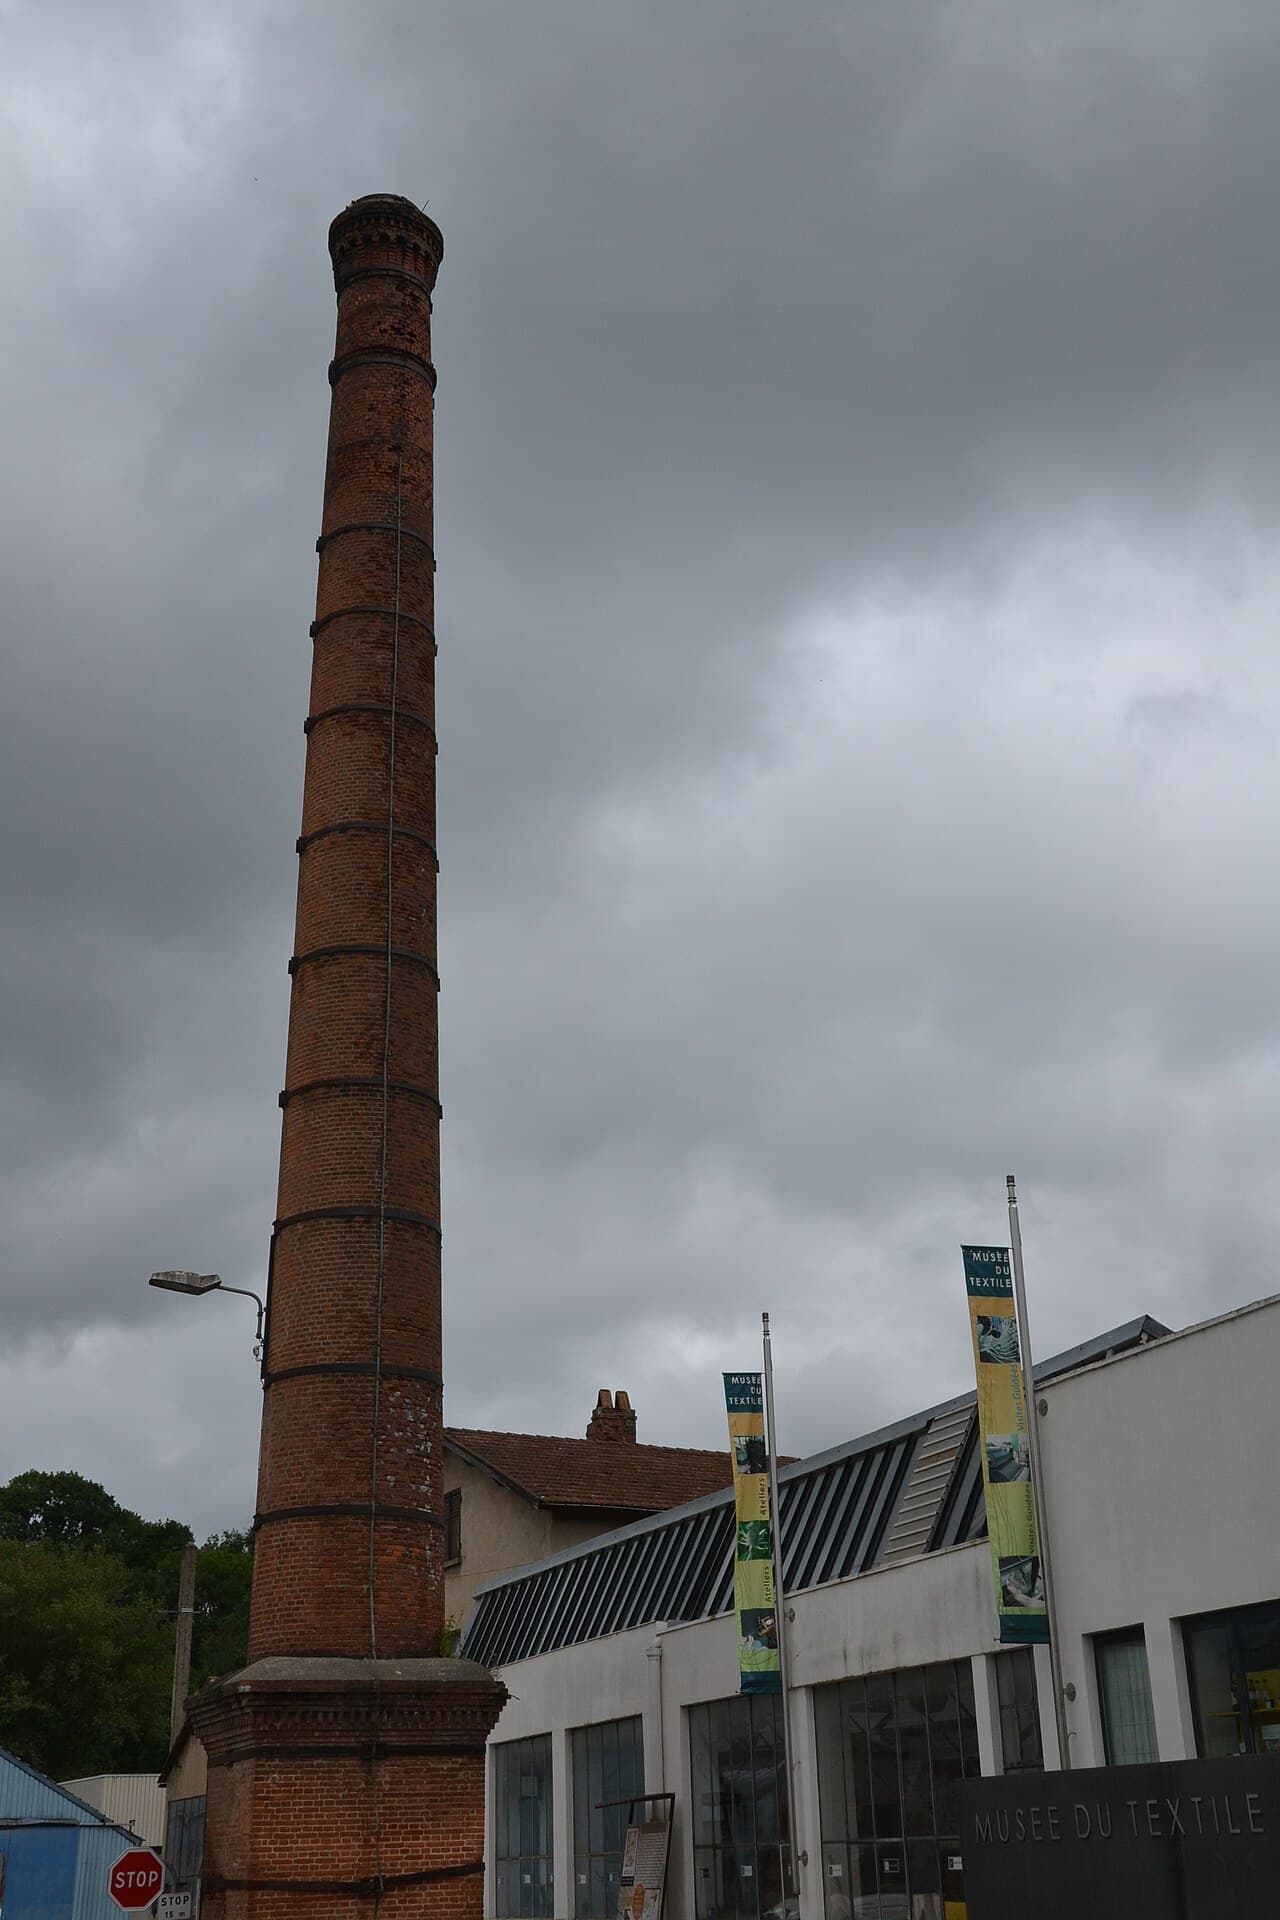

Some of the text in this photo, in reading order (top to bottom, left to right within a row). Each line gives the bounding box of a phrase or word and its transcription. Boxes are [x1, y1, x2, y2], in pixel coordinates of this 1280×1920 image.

[995, 1265, 1010, 1275] DU
[969, 1277, 1012, 1288] TEXTILE
[750, 1386, 762, 1395] DU
[728, 1397, 763, 1405] TEXTILE
[759, 1478, 767, 1516] Ateliers
[763, 1566, 772, 1603] Ateliers
[975, 1793, 1266, 1845] MUSEE DU TEXTILE
[114, 1870, 159, 1889] STOP
[161, 1895, 190, 1907] STOP
[165, 1910, 174, 1918] 15
